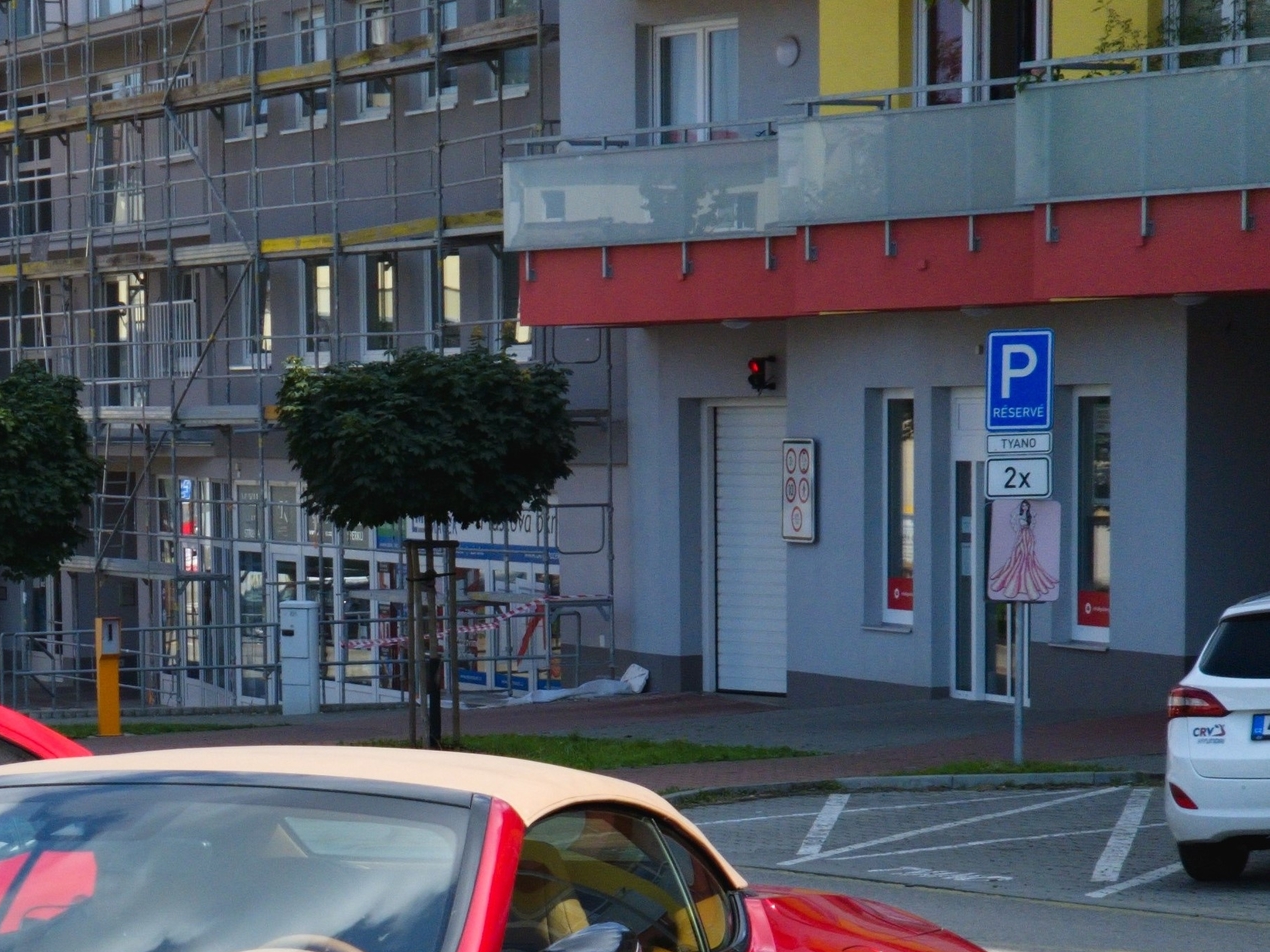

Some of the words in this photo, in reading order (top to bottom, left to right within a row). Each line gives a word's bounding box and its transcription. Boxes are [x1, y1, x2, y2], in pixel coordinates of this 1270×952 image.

[1001, 344, 1038, 398] P
[993, 404, 1045, 418] RÉSERVÉ
[1000, 438, 1037, 449] TYANO
[1004, 466, 1031, 489] 2x
